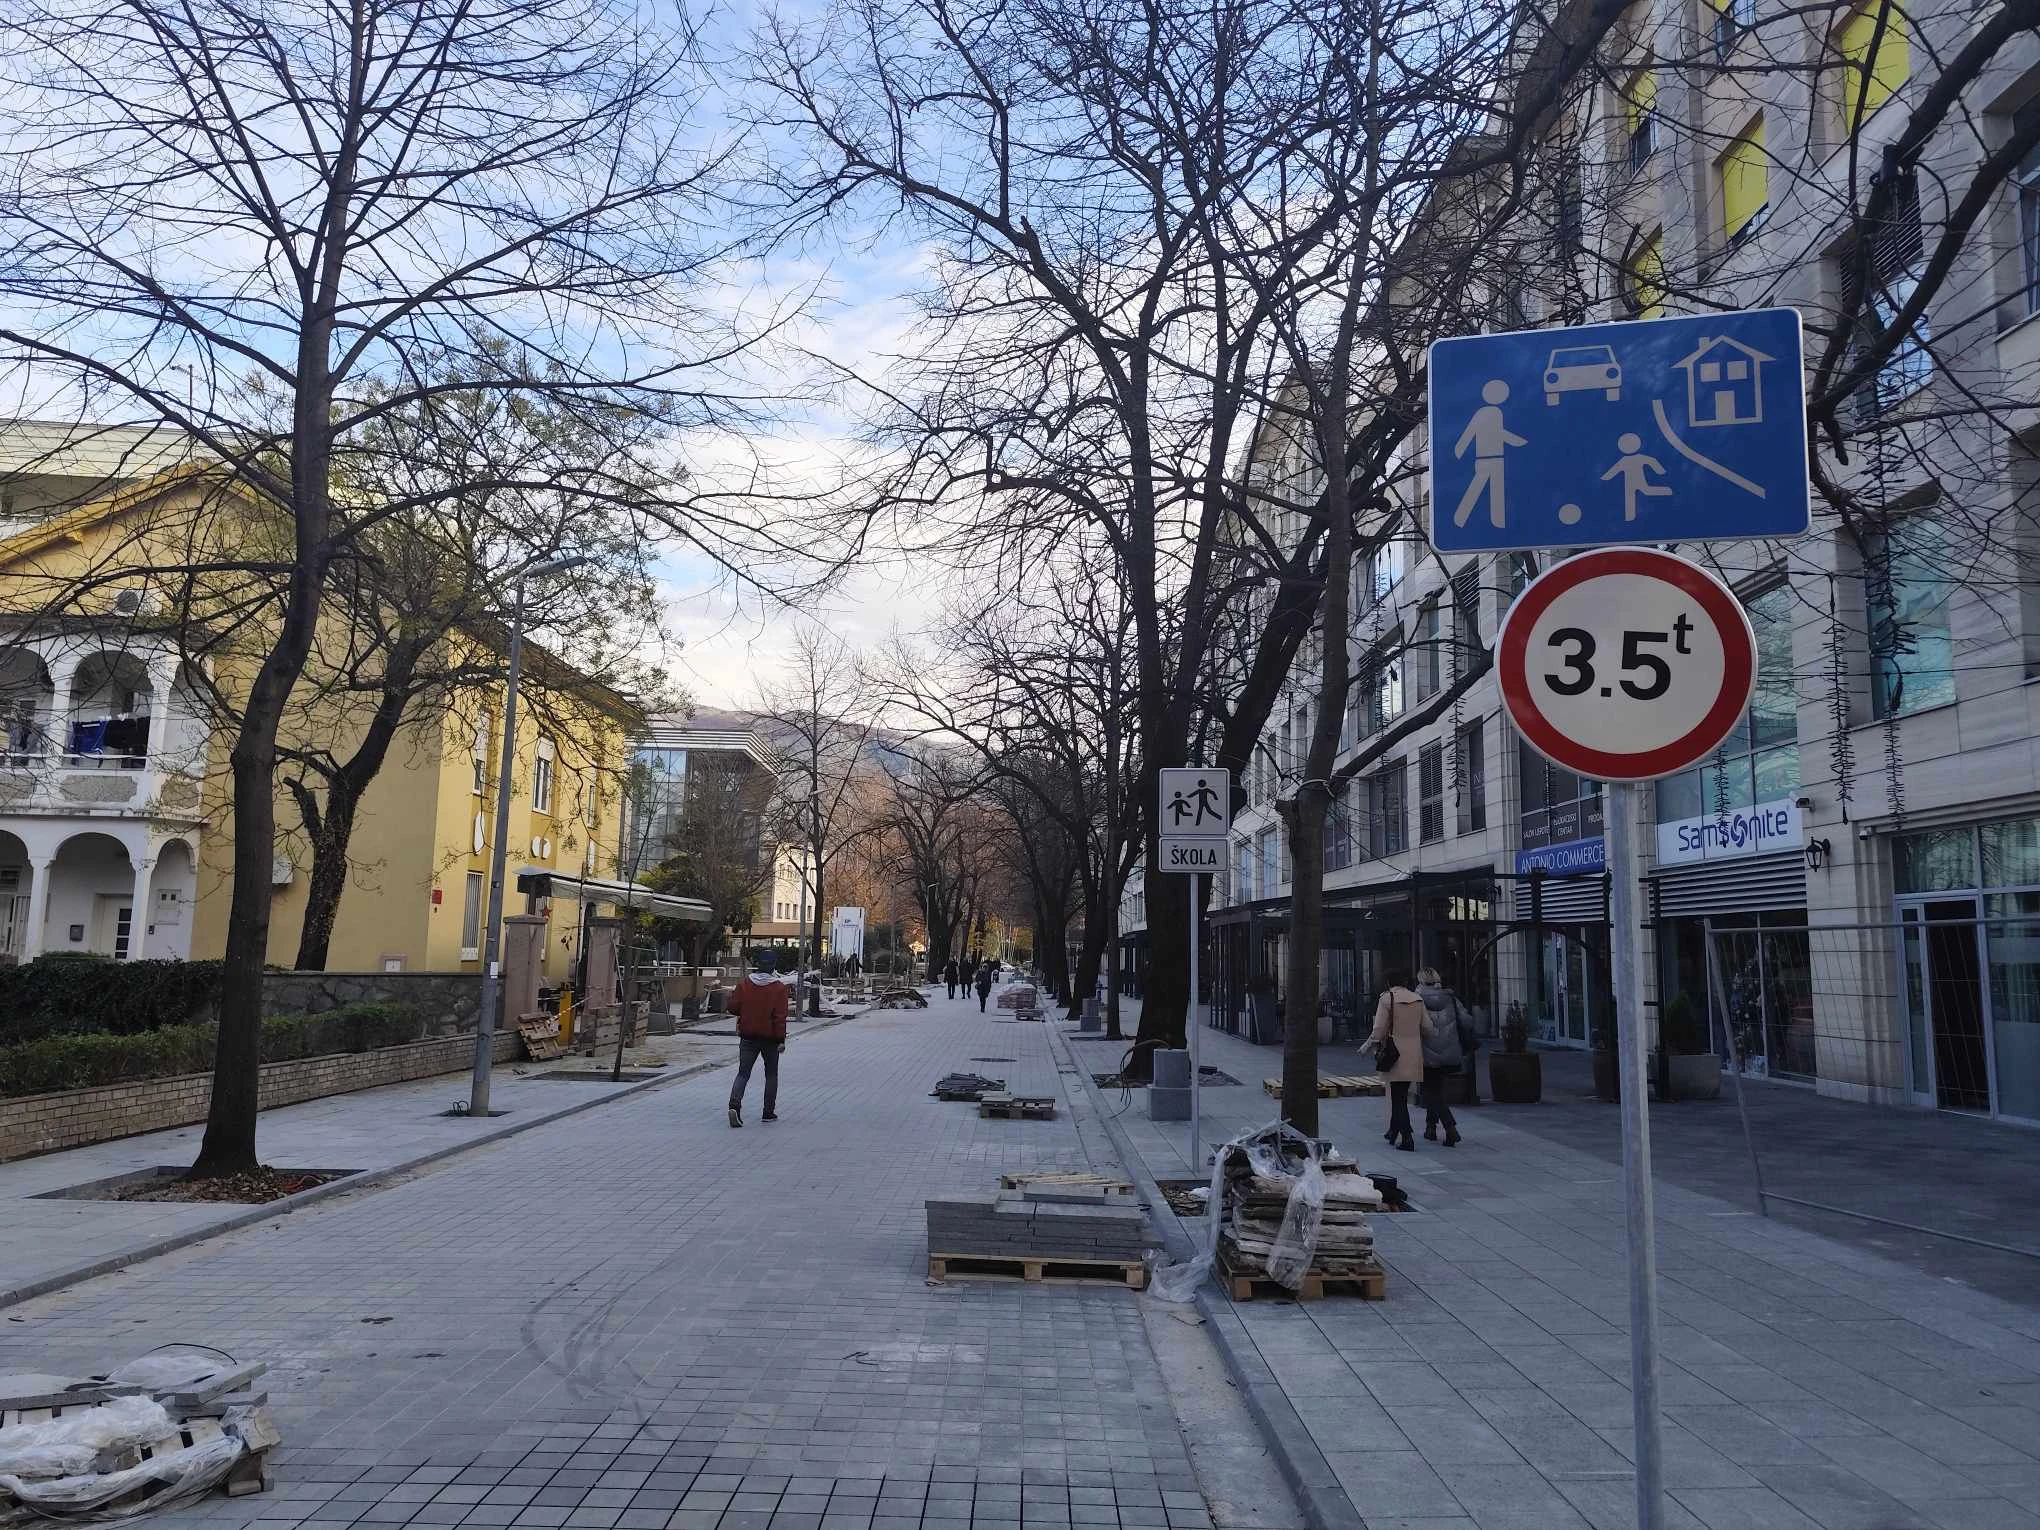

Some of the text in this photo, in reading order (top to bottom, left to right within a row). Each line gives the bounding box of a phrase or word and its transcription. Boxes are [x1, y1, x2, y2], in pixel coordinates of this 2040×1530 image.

[1678, 809, 1788, 851] Samsonite
[1171, 844, 1217, 865] ŠKOLA
[1521, 845, 1604, 874] ANTONIO COMMERCE
